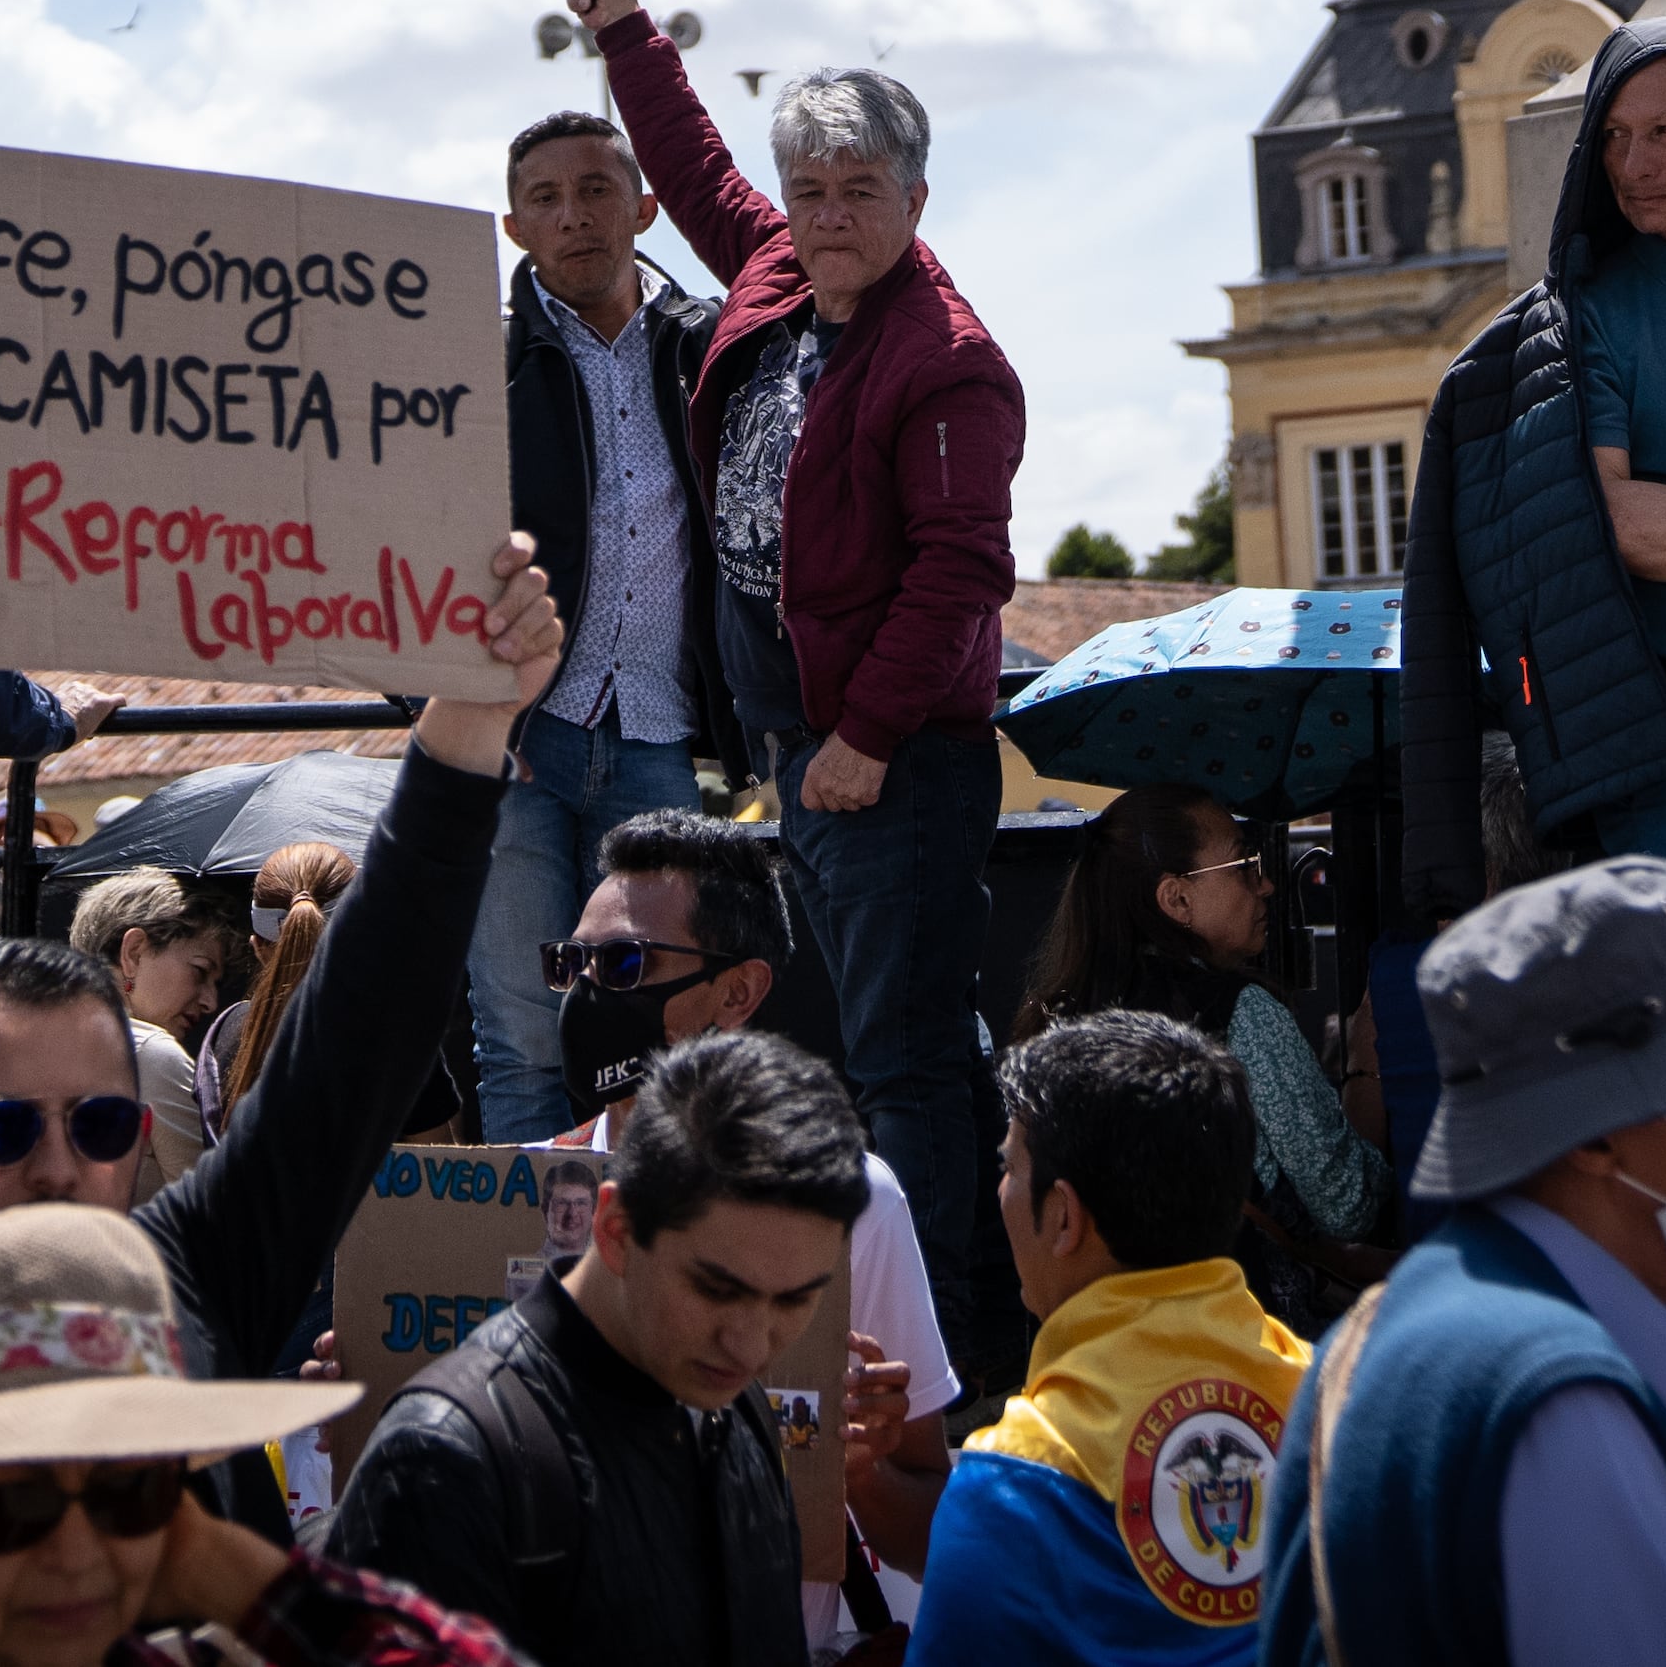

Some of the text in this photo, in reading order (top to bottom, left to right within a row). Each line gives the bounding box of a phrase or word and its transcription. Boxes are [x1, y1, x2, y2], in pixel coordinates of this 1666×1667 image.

[112, 230, 429, 353] póngase
[370, 381, 471, 465] por
[500, 1154, 540, 1207] A
[1132, 1381, 1284, 1459] REPUBLICA
[1137, 1540, 1261, 1617] DE COLO
